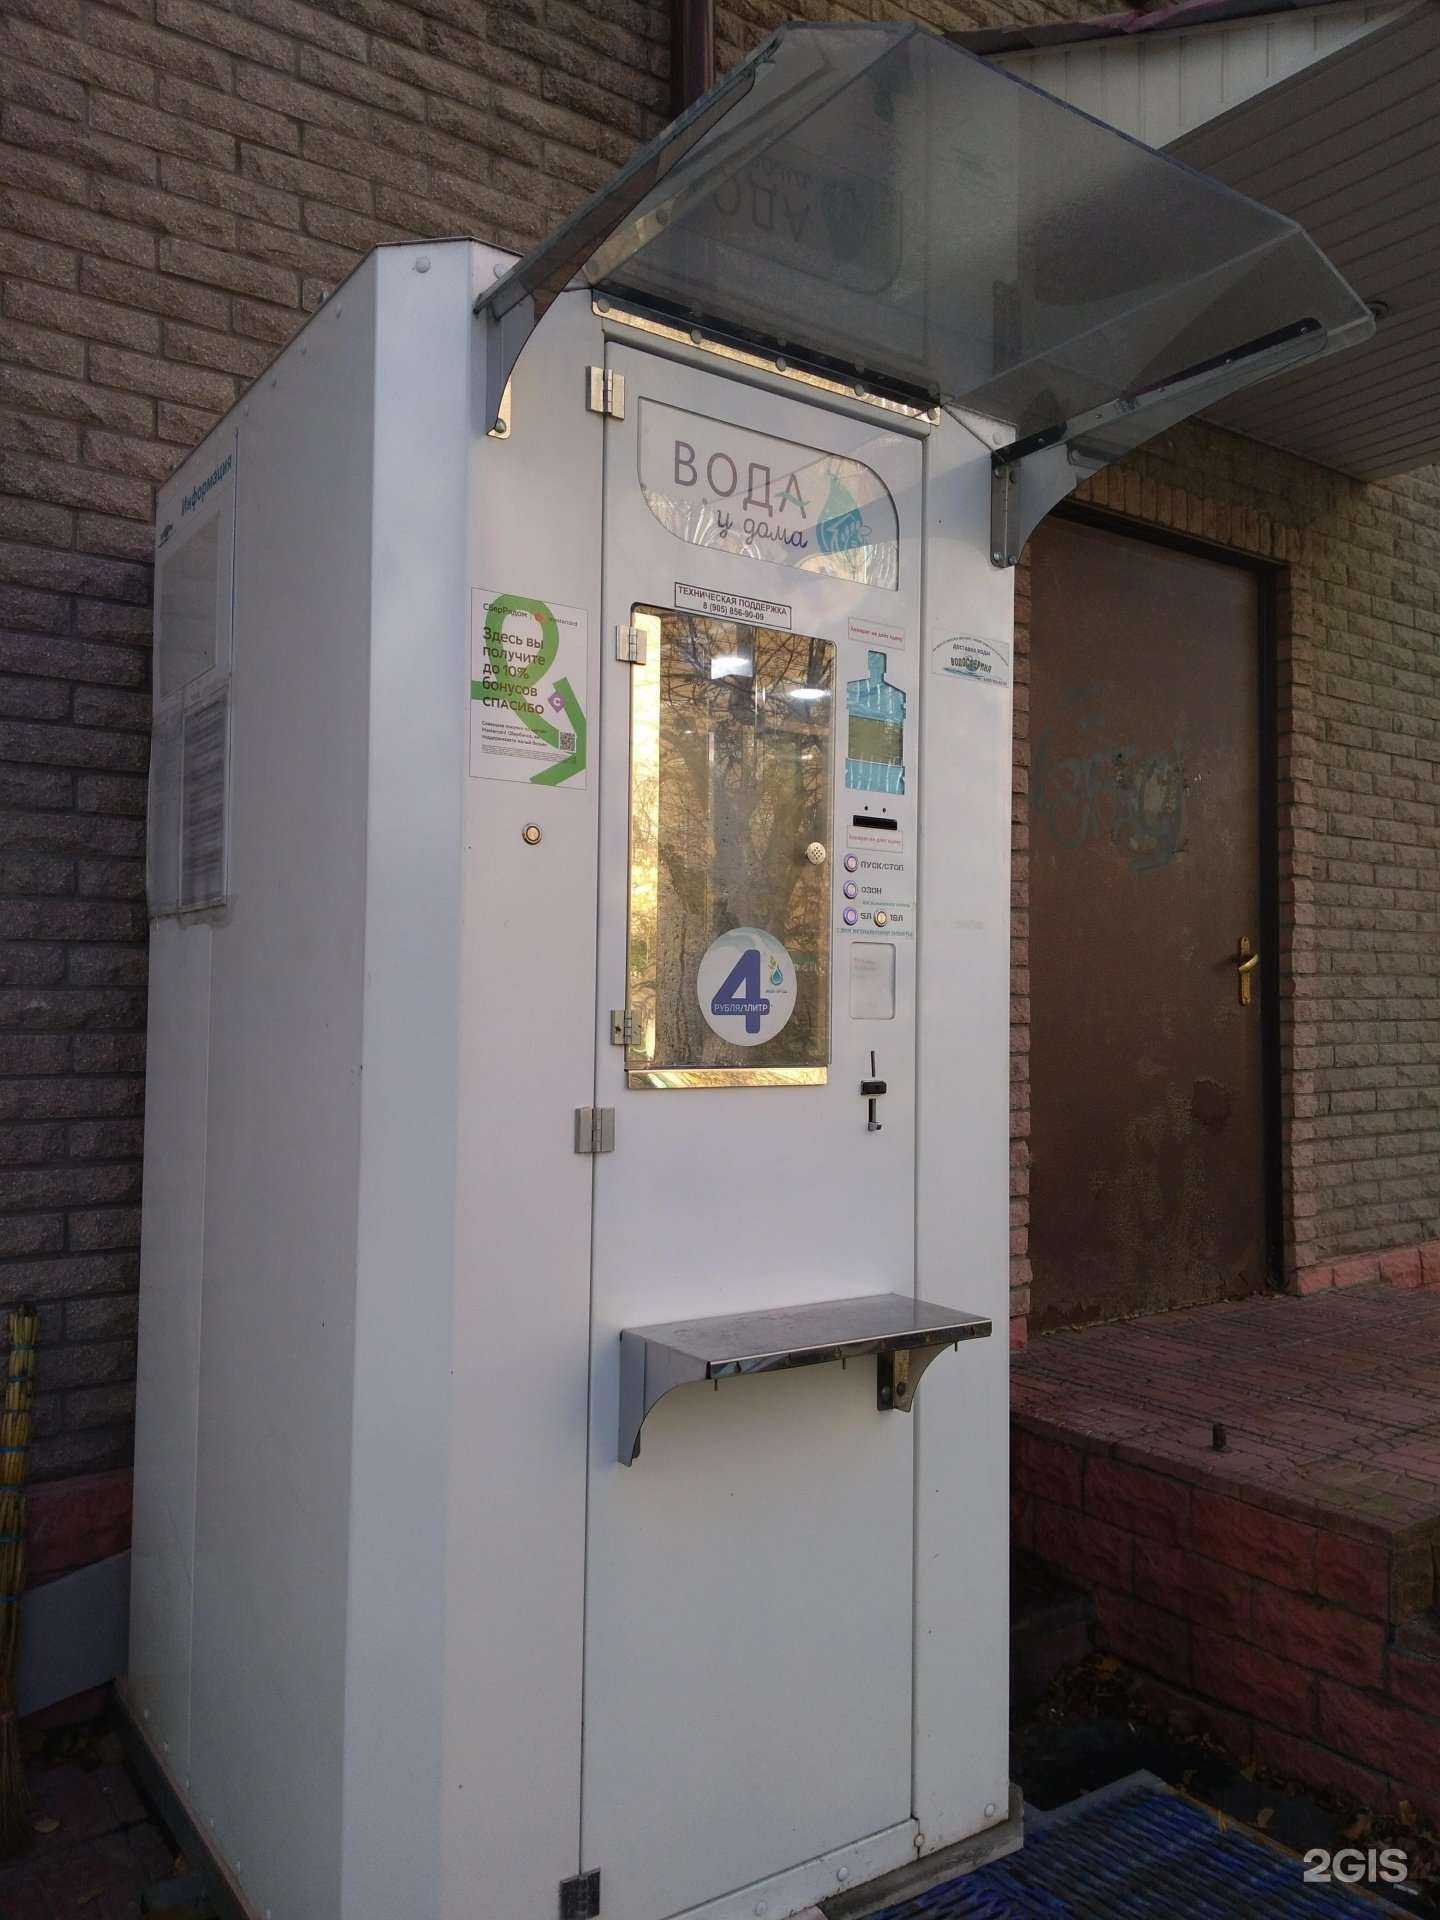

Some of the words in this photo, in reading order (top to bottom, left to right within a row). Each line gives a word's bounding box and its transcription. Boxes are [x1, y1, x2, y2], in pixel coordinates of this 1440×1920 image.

[181, 454, 232, 516] Информация
[674, 440, 807, 519] ВОДА
[717, 510, 733, 539] у
[744, 518, 809, 549] дома
[678, 586, 737, 606] ТЕХНИЧЕСКАЯ
[738, 598, 787, 616] ПОДДЕРЖКА
[702, 601, 708, 610] 8
[709, 603, 728, 616] (905)
[483, 626, 523, 646] Здесь
[526, 637, 544, 650] вы
[483, 646, 546, 666] получите
[483, 663, 500, 676] до
[503, 665, 529, 680] 10%
[482, 676, 538, 697] бонусов
[482, 696, 545, 715] СПАСИБО
[860, 860, 905, 872] ПУСК/СТОП
[711, 949, 770, 1034] 4
